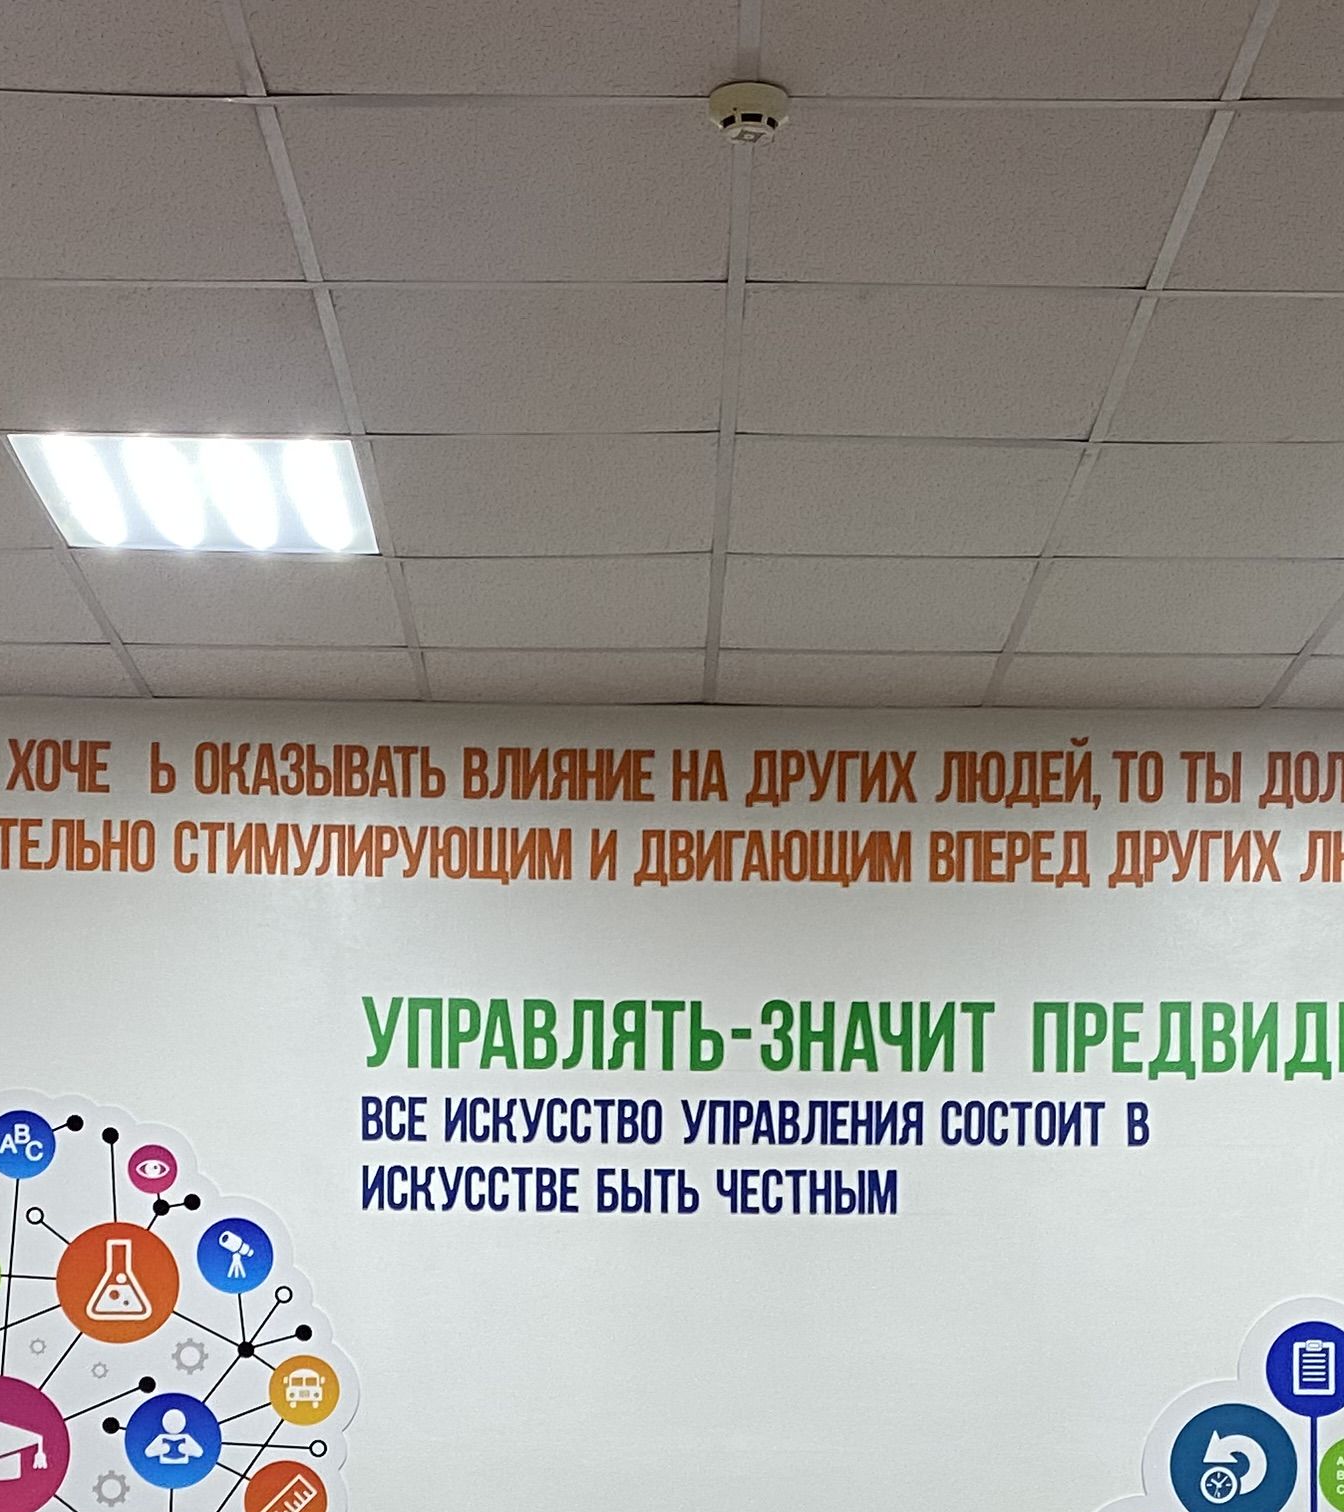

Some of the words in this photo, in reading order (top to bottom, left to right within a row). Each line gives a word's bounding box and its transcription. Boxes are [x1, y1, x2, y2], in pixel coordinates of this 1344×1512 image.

[194, 741, 446, 801] ОКАЗЫВАТЬ
[463, 747, 653, 803] ВЛИЯНИЕ
[673, 750, 726, 803] НА
[746, 749, 916, 808] ДРУГИХ
[936, 737, 1101, 809] ЛЮДЕЙ,
[1115, 750, 1164, 805] ТО
[1182, 750, 1242, 806] ТЫ
[172, 820, 573, 887] СТИМУЛИРУЮЩИМ
[589, 828, 619, 882] И
[632, 828, 913, 889] ДВИГАЮЩИМ
[928, 829, 1091, 889] ВПЕРЕД
[1107, 829, 1280, 889] ДРУГИХ
[362, 996, 996, 1073] УПРАВЛЯТЬ-ЗНАЧИТ
[361, 1095, 428, 1143] ВСЕ
[444, 1097, 664, 1145] ИСКУССТВО
[682, 1099, 924, 1146] УПРАВЛЕНИЯ
[941, 1100, 1106, 1147] СОСТОИТ
[1126, 1101, 1151, 1147] В
[361, 1165, 579, 1213] ИСКУССТВЕ
[596, 1167, 700, 1214] БЫТЬ
[716, 1168, 898, 1215] ЧЕСТНЫМ
